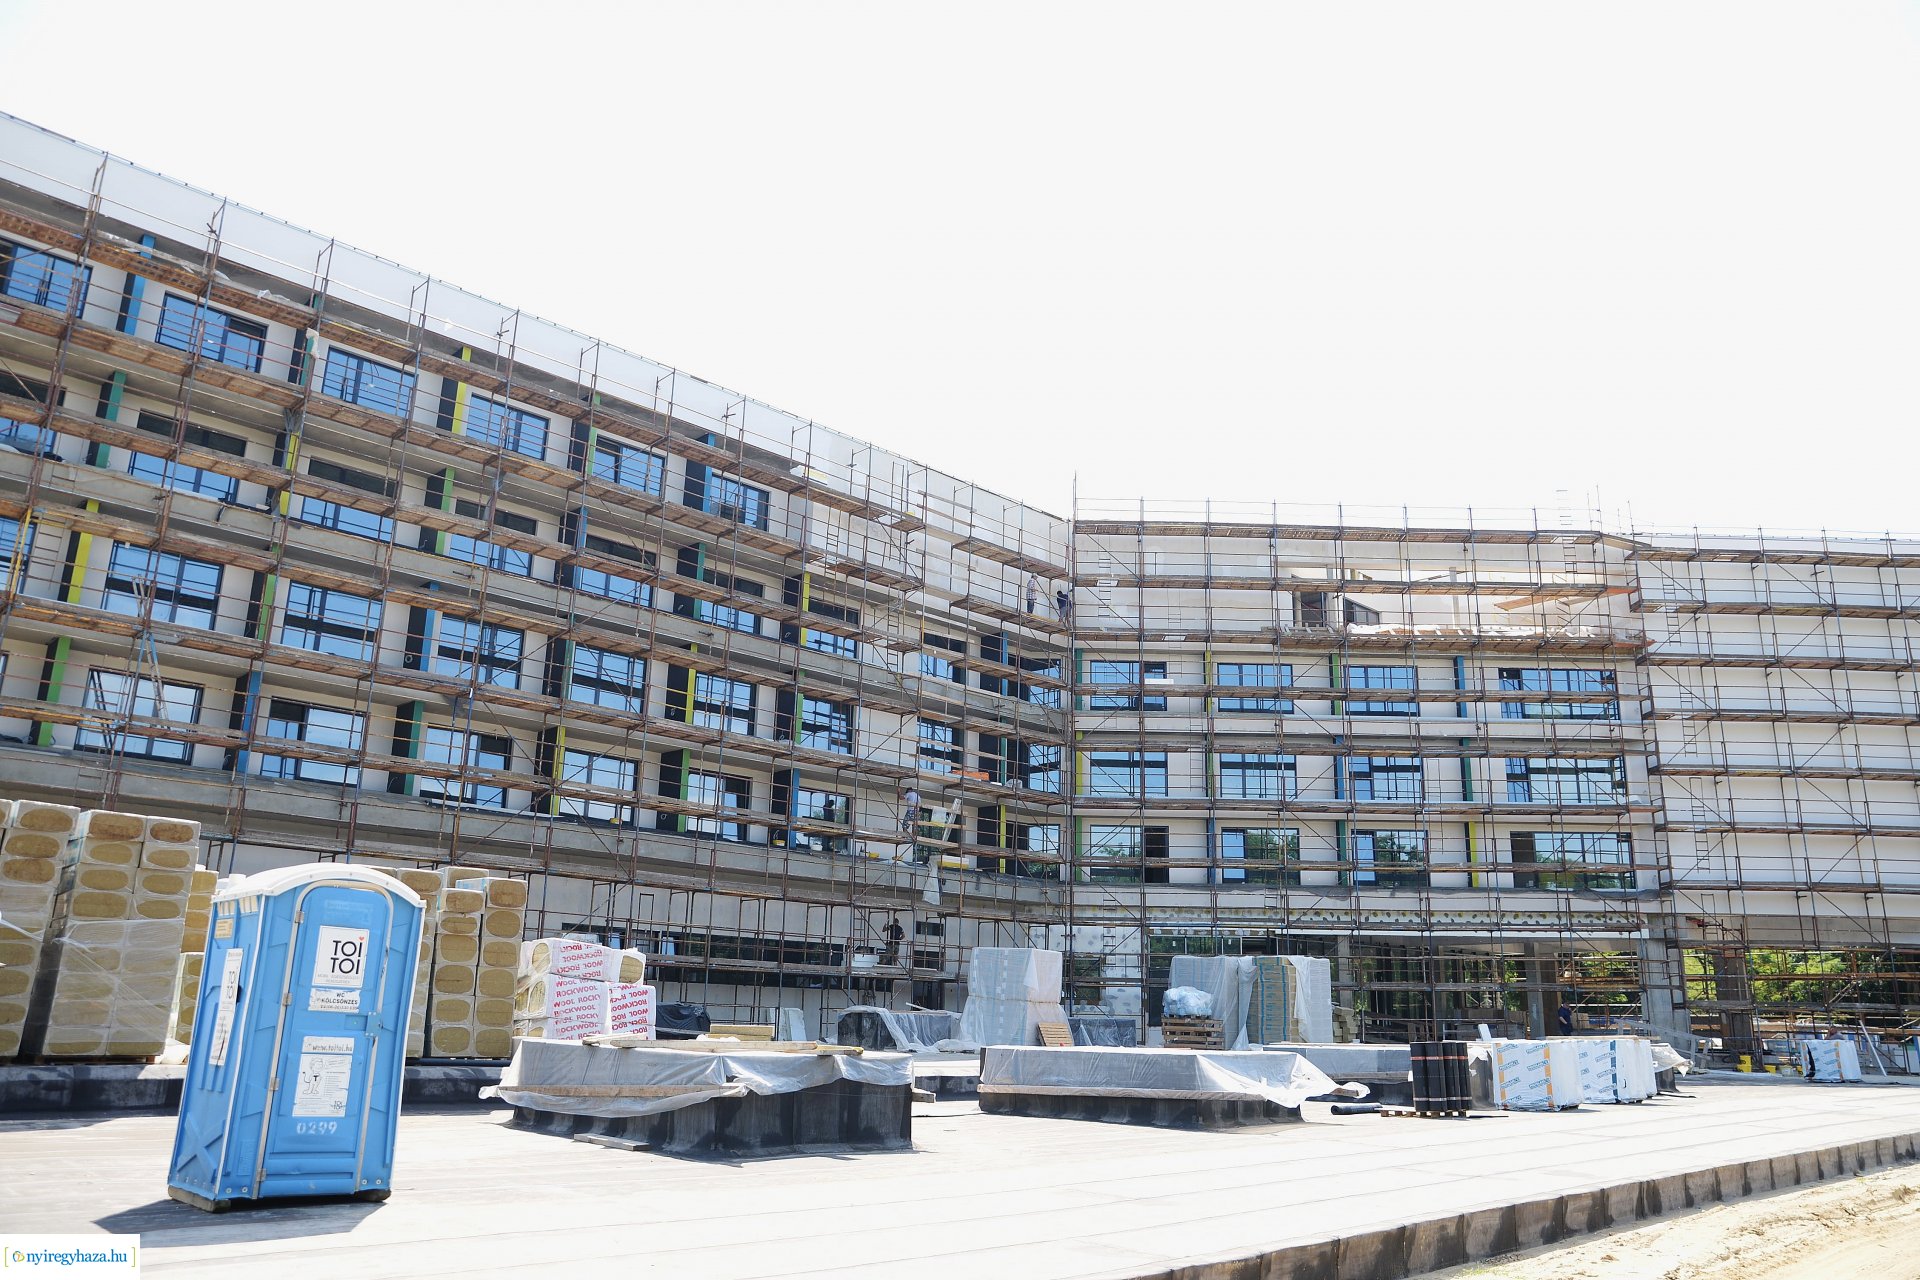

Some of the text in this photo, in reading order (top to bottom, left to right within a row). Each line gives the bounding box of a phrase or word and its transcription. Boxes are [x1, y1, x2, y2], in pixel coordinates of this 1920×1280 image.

[332, 940, 363, 958] TOI
[330, 957, 361, 975] TOI
[556, 985, 598, 998] ROCKWOOL
[629, 990, 649, 998] WOOL
[629, 1008, 649, 1017] WOOL
[296, 1121, 337, 1135] 0299
